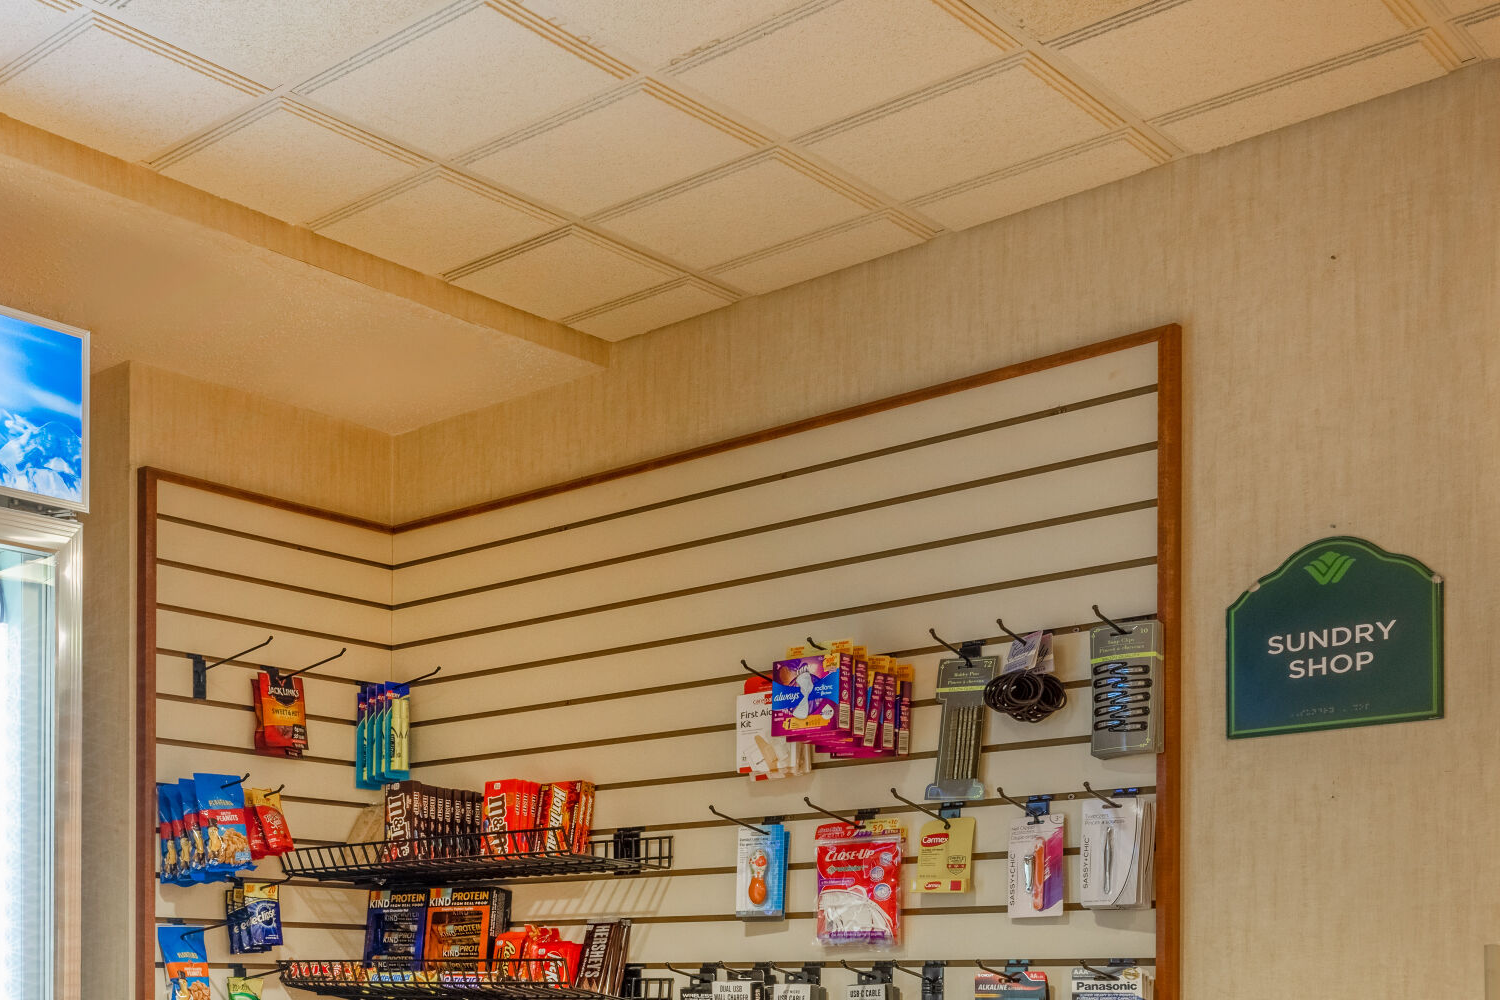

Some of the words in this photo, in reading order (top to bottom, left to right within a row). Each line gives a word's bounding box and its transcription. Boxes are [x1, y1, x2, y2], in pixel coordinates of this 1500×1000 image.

[1267, 620, 1397, 655] SUNDRY
[1288, 651, 1374, 679] SHOP
[268, 686, 282, 696] JACK
[774, 691, 800, 702] always
[740, 711, 758, 719] First
[216, 813, 238, 822] PEANUTS
[922, 835, 948, 844] Carmex
[825, 849, 875, 862] CLOSE-UP
[369, 899, 390, 909] KIND
[391, 893, 426, 903] PROTEIN
[429, 897, 451, 907] KIND
[452, 891, 489, 901] PROTEIN
[585, 924, 608, 979] HERSHEY'S
[1076, 982, 1137, 991] Panasonic
[850, 990, 865, 998] USB-C
[866, 989, 881, 997] CABLE
